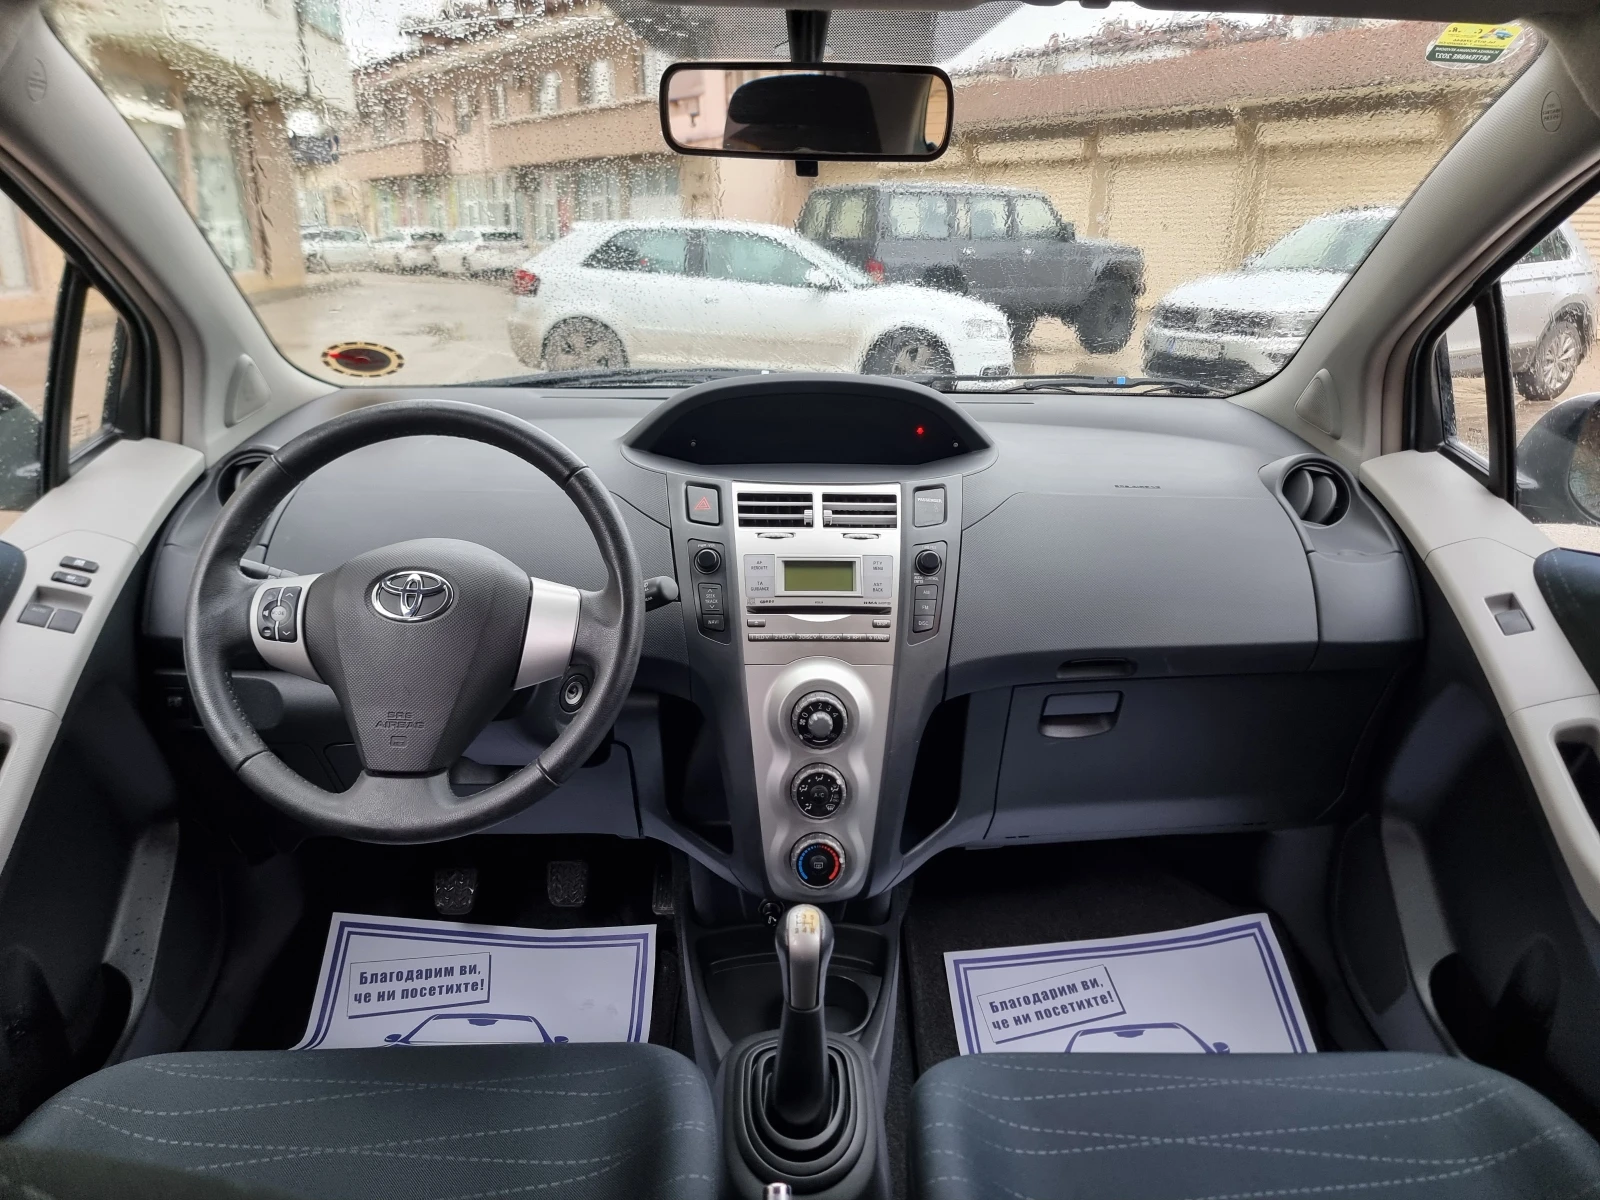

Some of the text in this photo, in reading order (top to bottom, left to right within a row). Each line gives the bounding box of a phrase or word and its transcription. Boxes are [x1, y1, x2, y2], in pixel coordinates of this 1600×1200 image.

[374, 720, 425, 729] AIRBAG
[359, 964, 481, 985] Благодарим ви,
[354, 978, 485, 1004] че ни посетихте!
[989, 977, 1104, 1013] Благодарим ви,
[991, 990, 1115, 1031] че ни посетихте!
